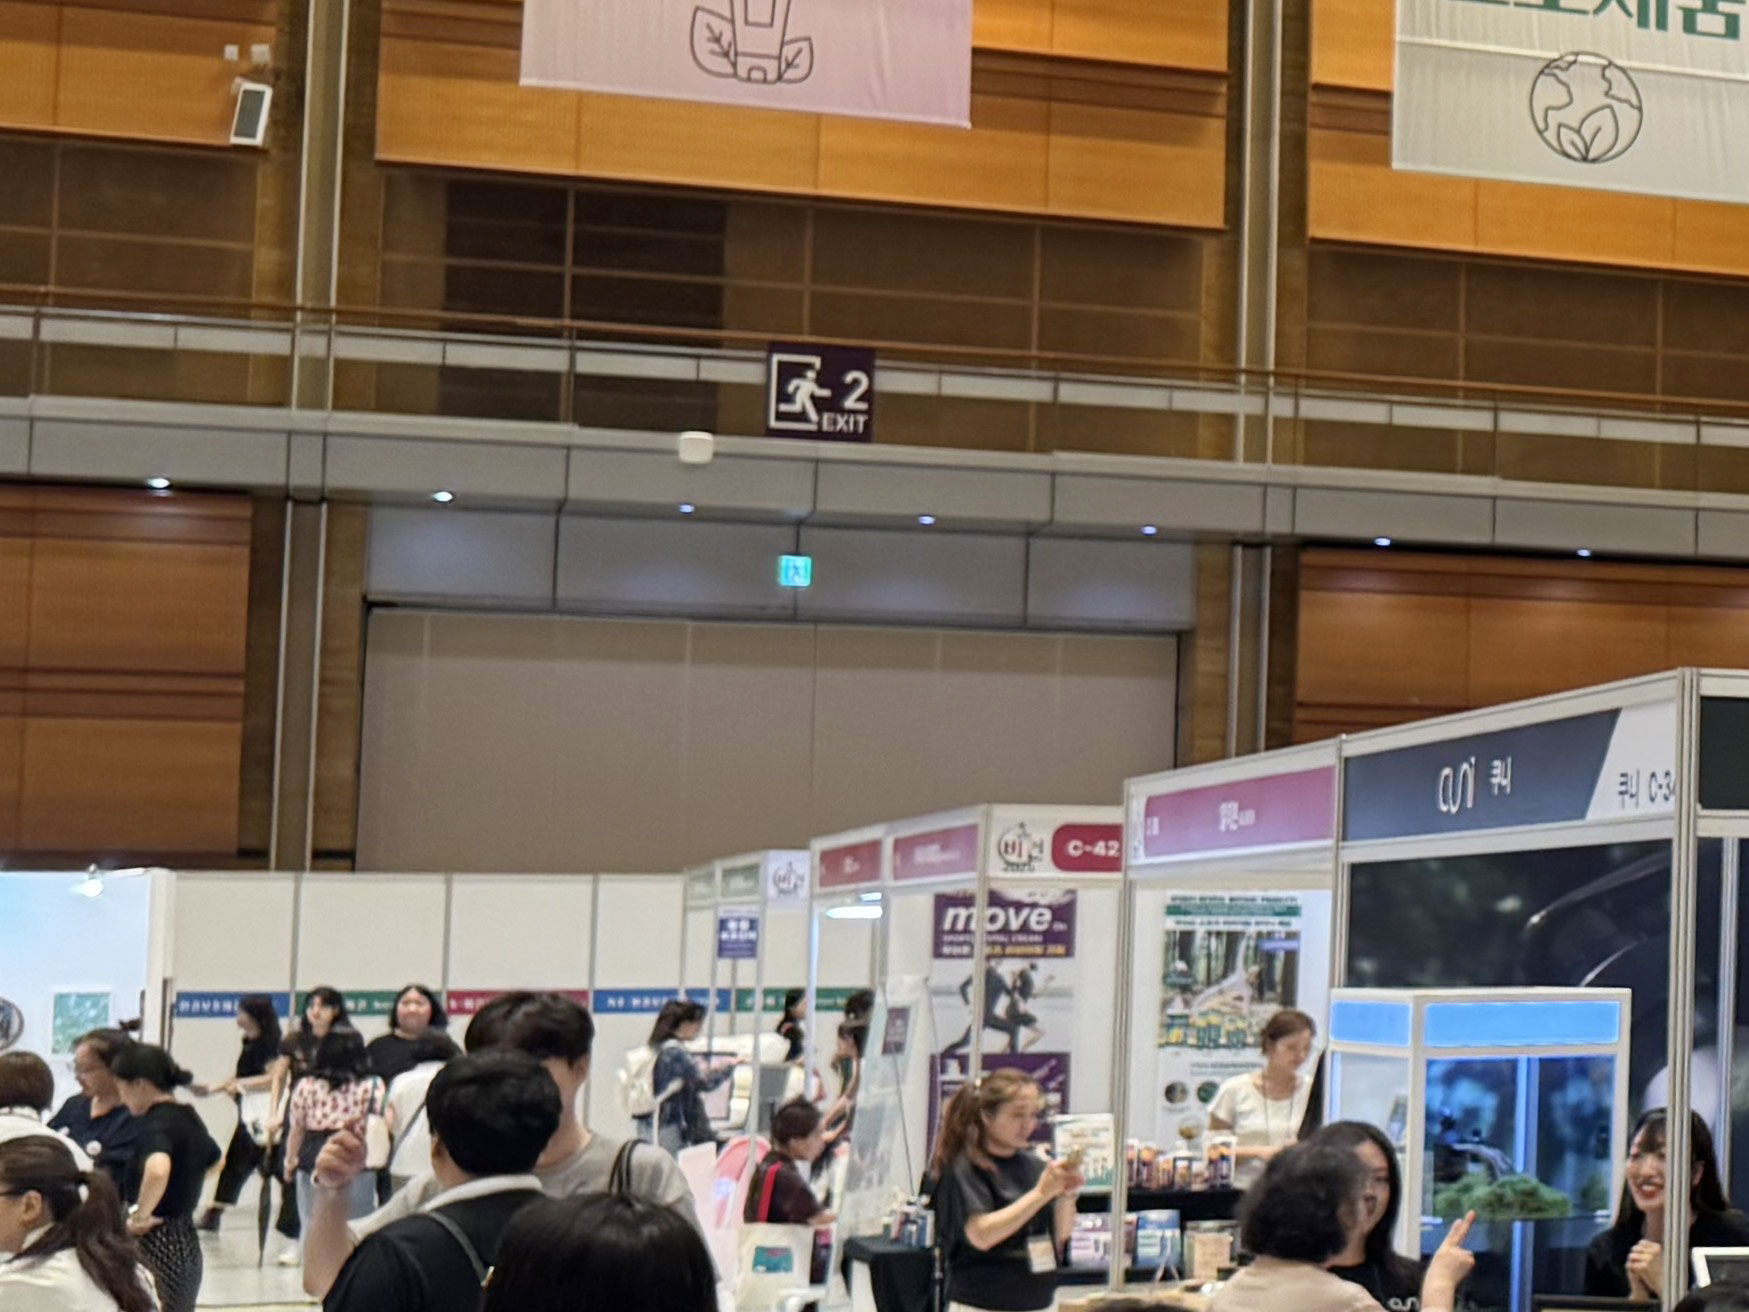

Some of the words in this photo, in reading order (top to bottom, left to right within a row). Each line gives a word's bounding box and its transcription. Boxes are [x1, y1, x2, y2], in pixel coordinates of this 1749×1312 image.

[844, 370, 869, 410] 2
[822, 412, 868, 434] EXIT
[1618, 769, 1640, 809] 쿠니
[1067, 839, 1121, 857] C-42
[943, 906, 1052, 932] move
